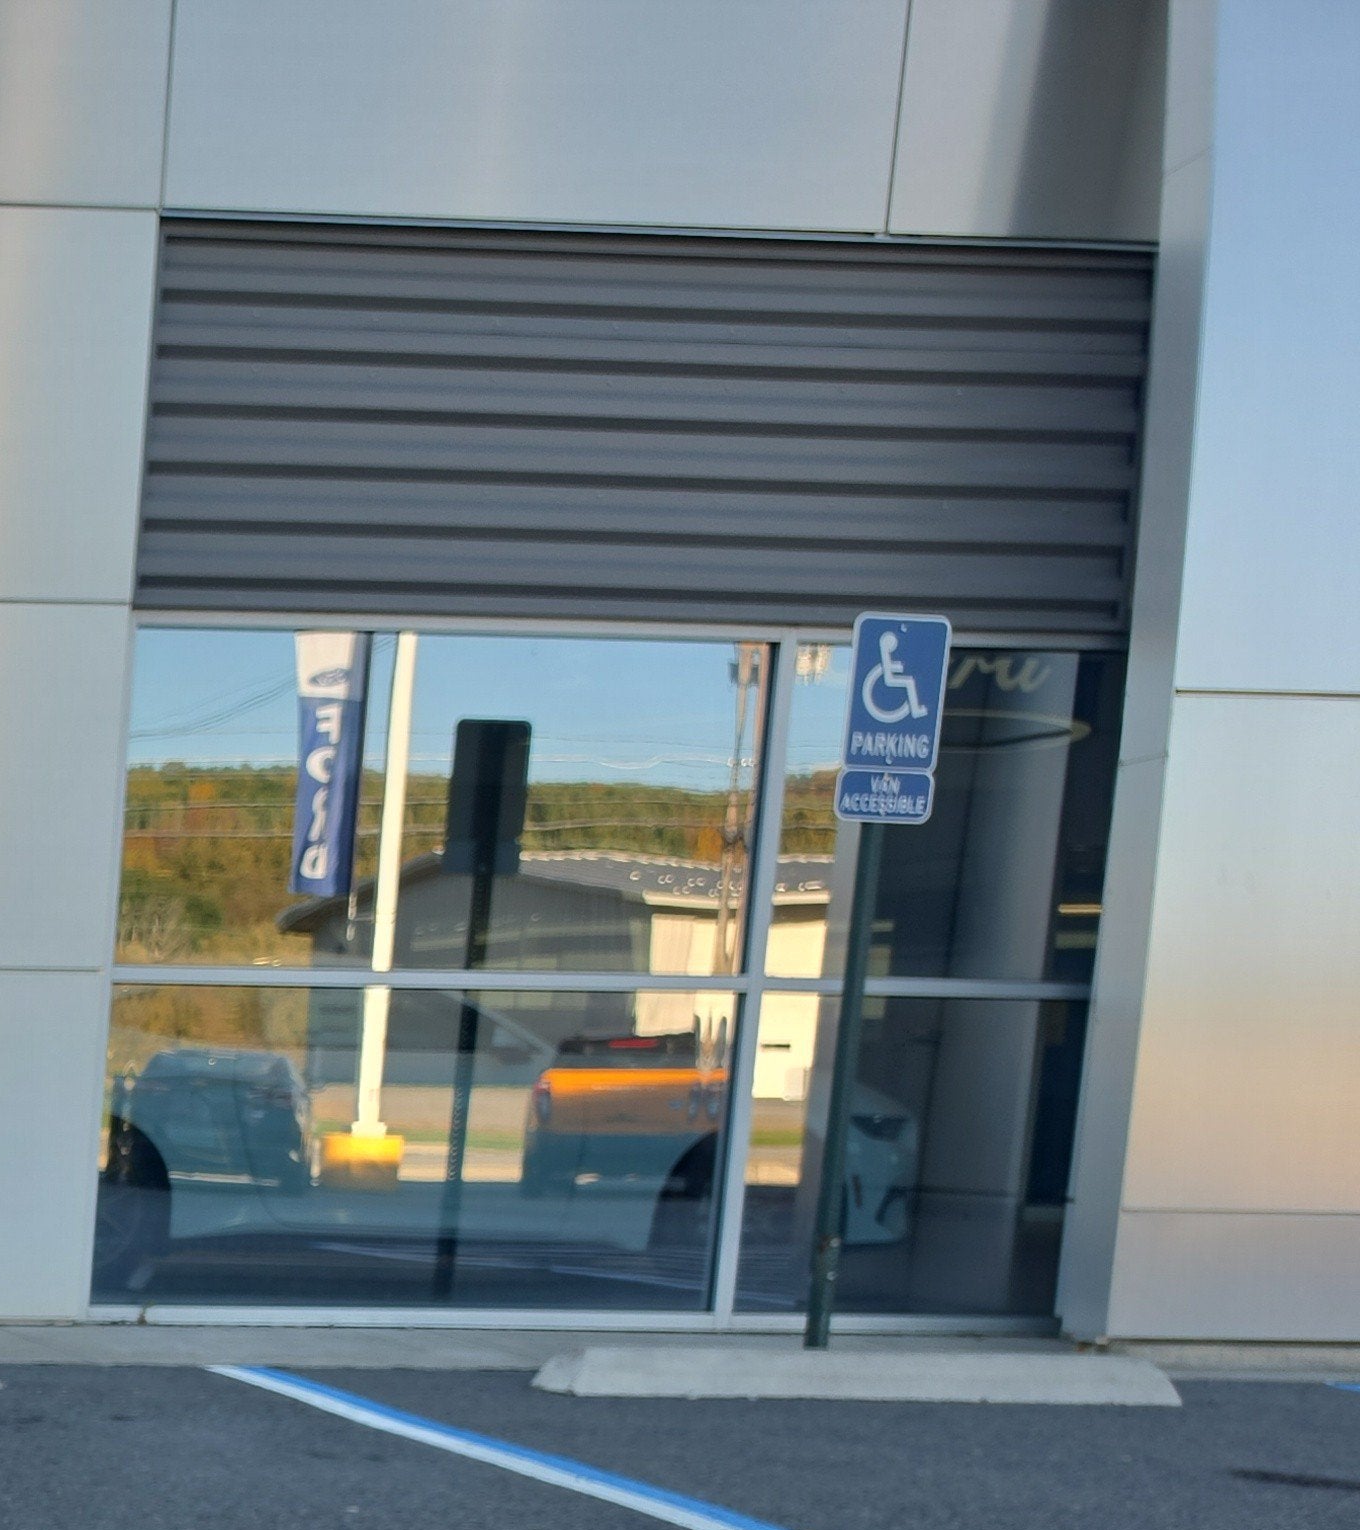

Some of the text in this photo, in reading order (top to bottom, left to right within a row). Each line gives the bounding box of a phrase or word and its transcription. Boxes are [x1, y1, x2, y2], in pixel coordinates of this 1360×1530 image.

[850, 731, 929, 758] PARKING
[870, 775, 900, 793] VAN
[840, 793, 925, 814] ACCESSIBLE
